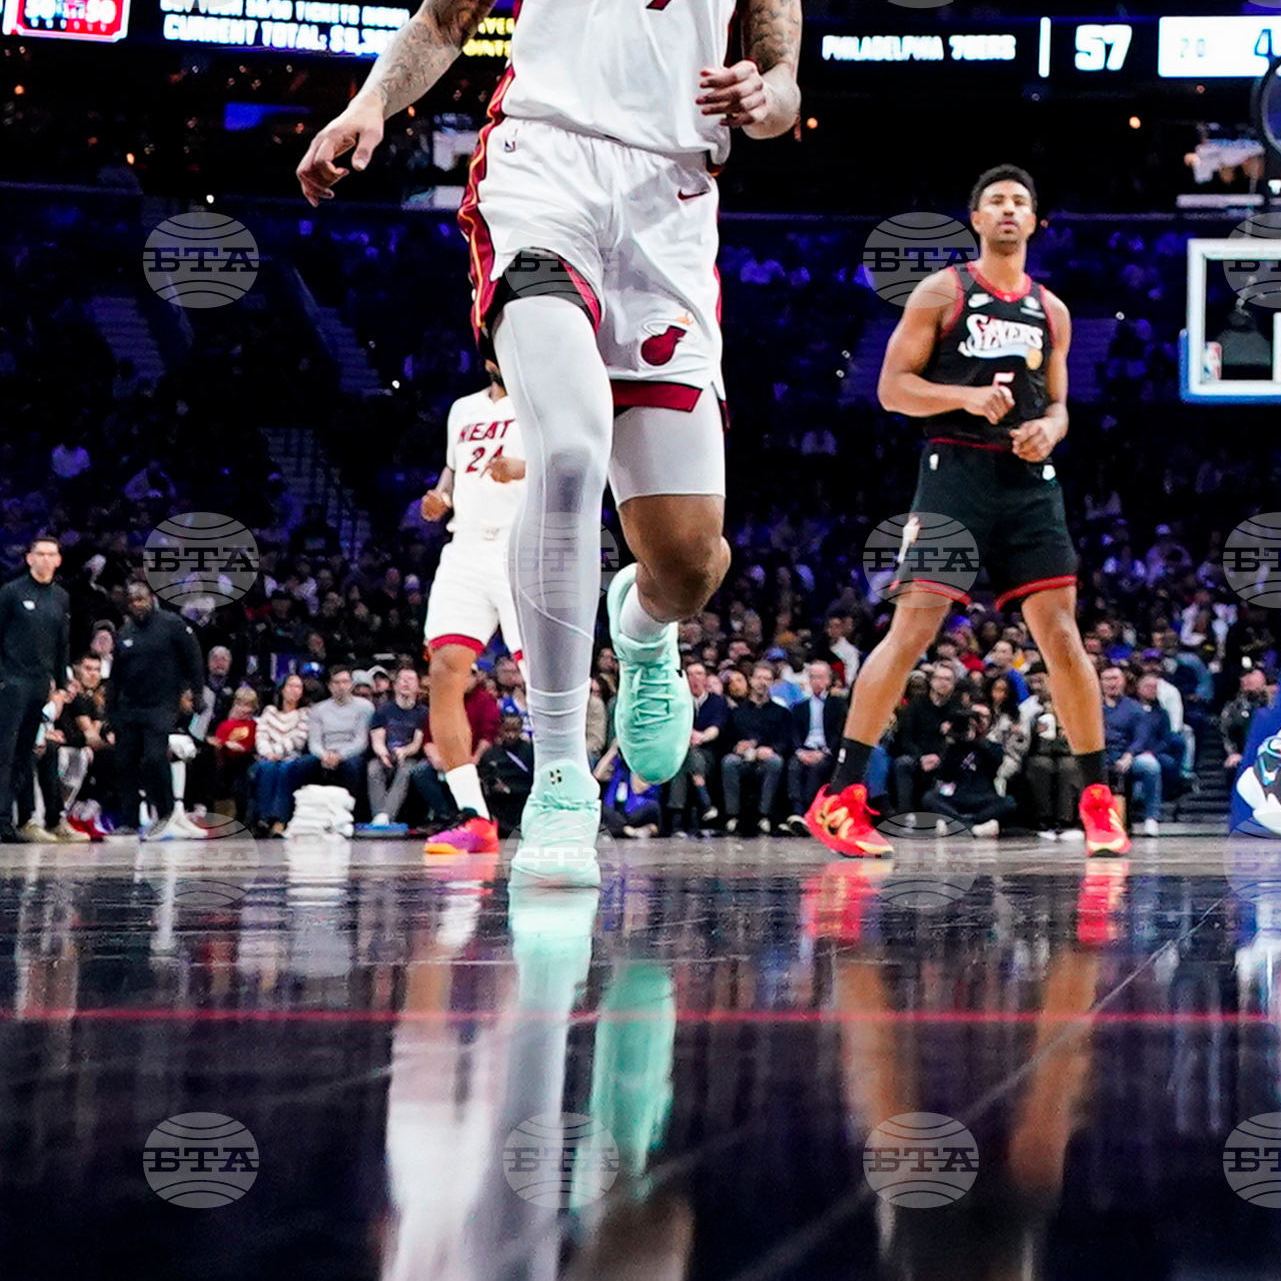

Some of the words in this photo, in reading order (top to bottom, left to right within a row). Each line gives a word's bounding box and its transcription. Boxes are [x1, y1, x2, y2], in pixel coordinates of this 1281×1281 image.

[163, 13, 259, 46] CURRENT
[822, 34, 945, 61] PHILADELPHIA
[1074, 23, 1133, 72] 57
[457, 418, 516, 445] HEAT
